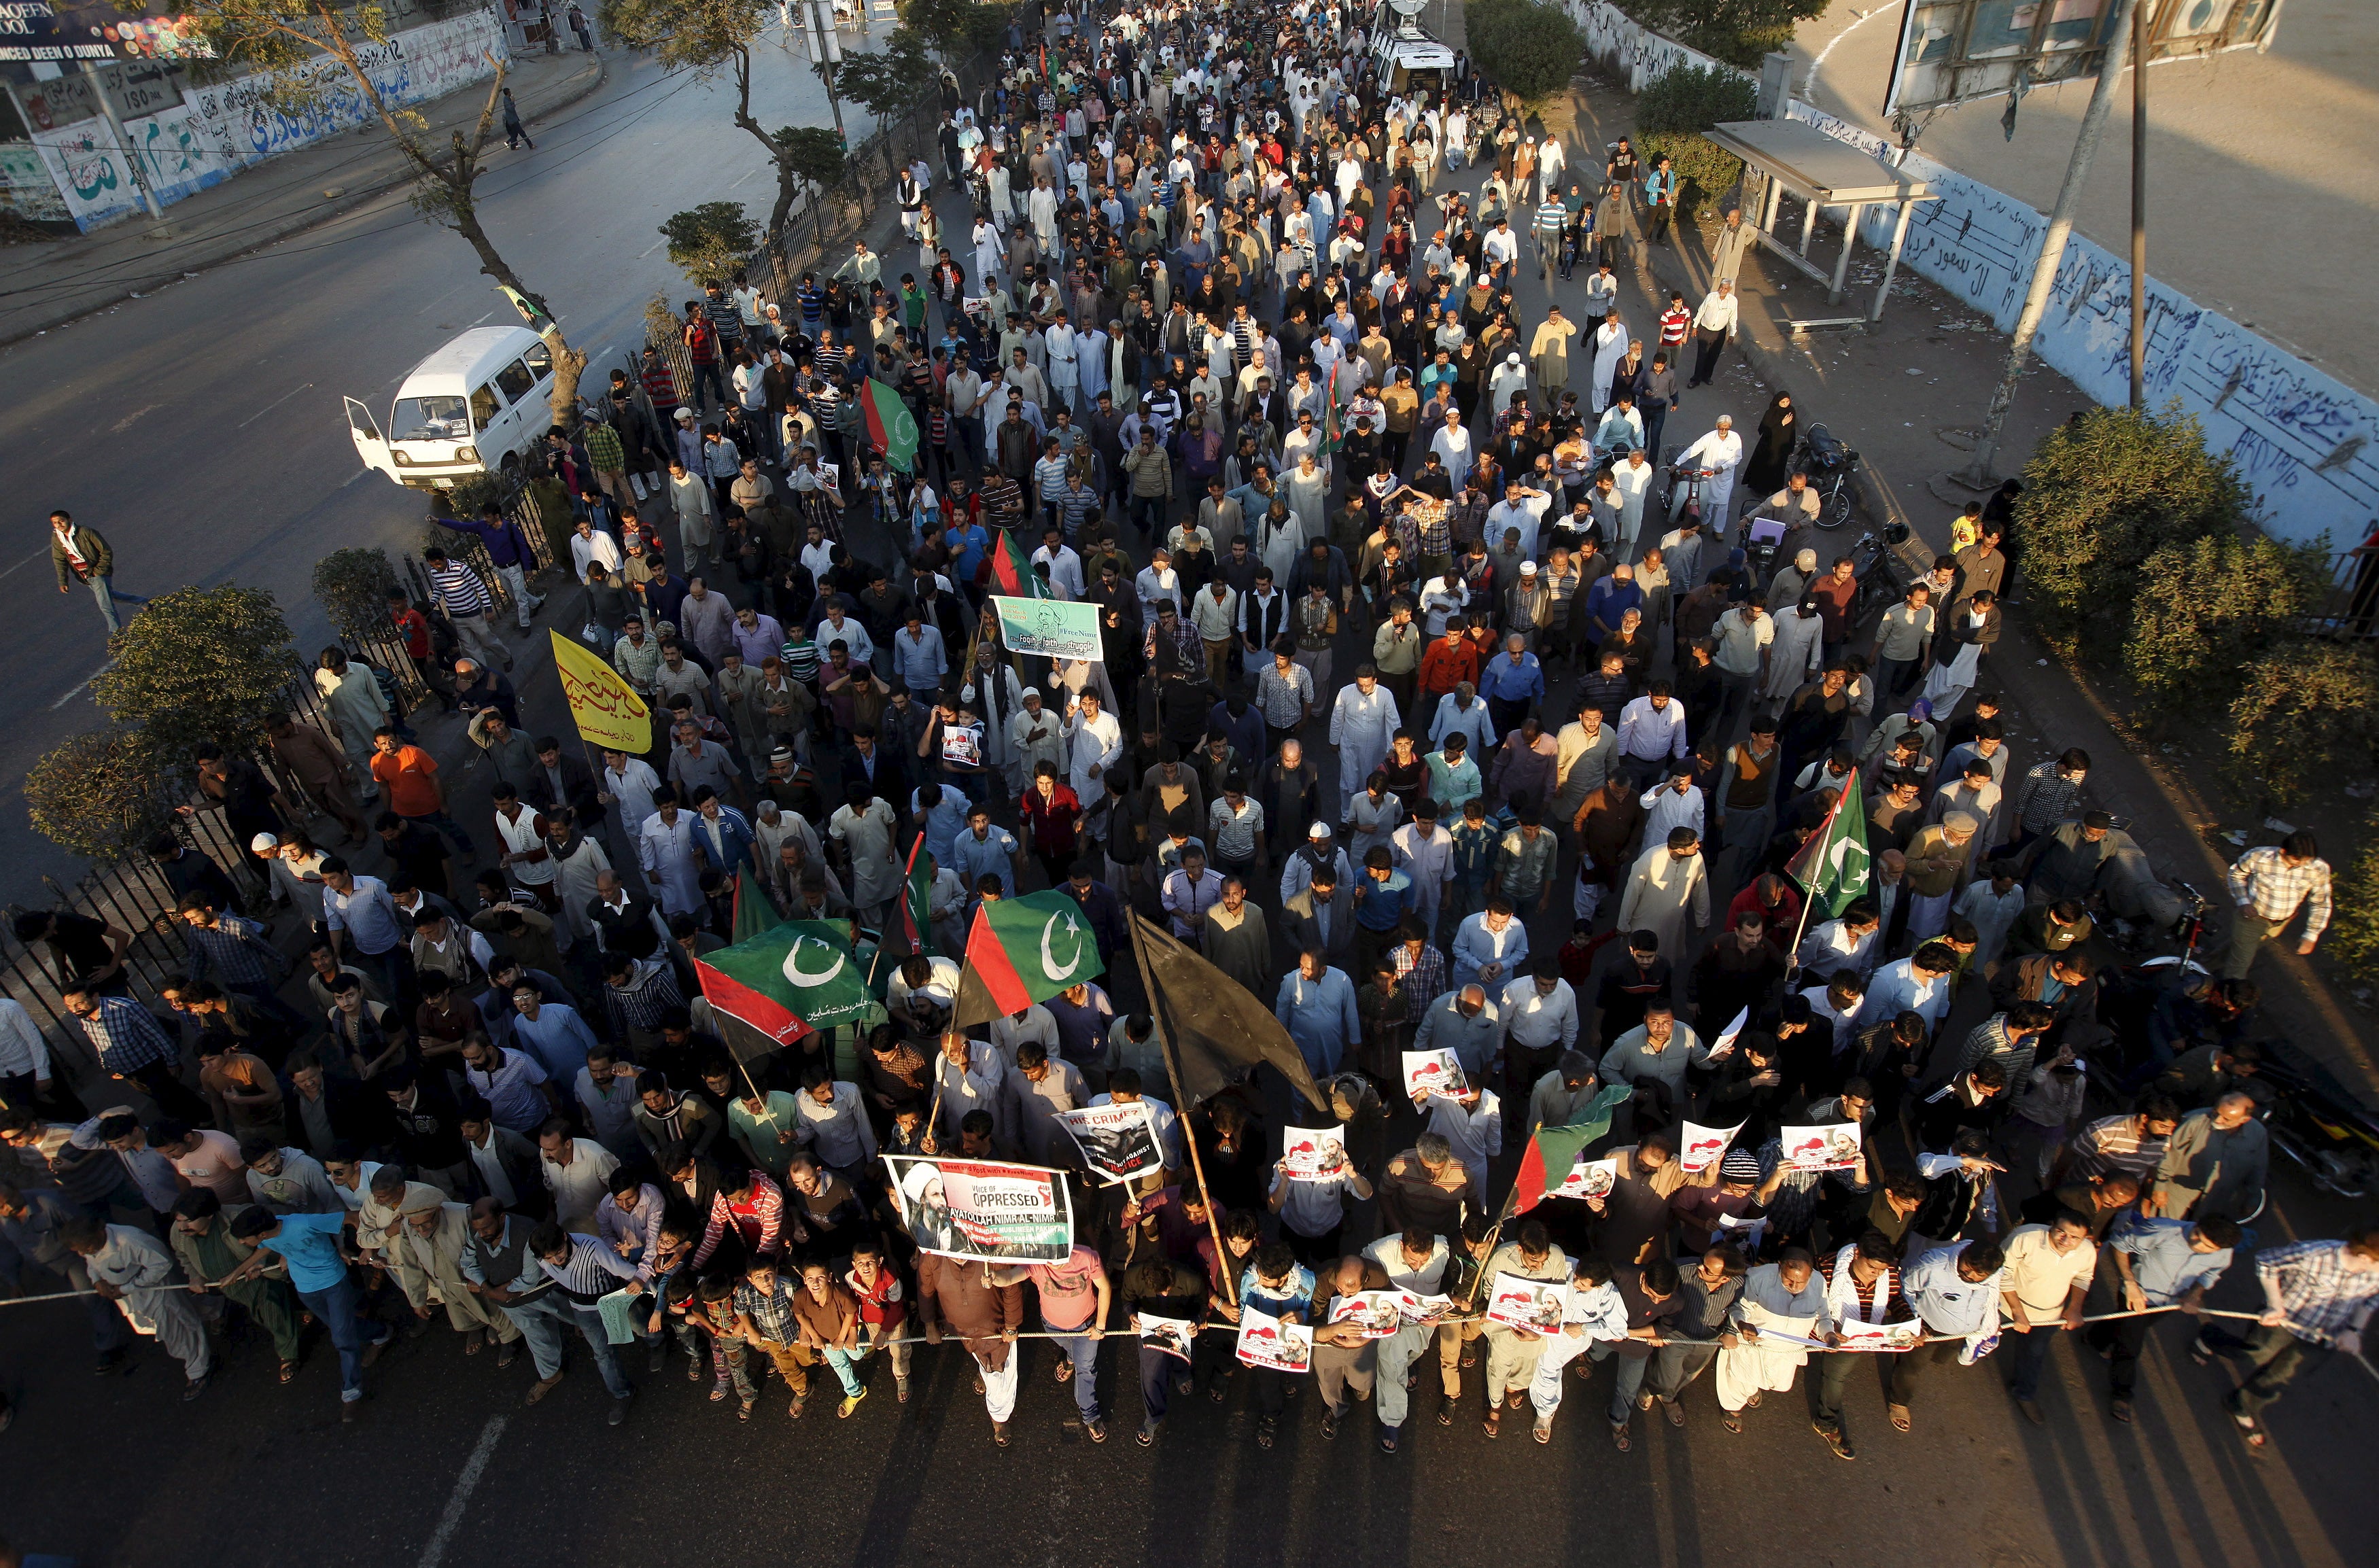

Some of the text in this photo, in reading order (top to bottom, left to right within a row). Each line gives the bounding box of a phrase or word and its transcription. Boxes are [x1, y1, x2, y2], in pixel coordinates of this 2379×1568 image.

[31, 46, 64, 60] DEEN
[63, 46, 74, 58] O
[73, 44, 115, 58] DUNYA
[123, 89, 149, 110] ISO
[1060, 627, 1097, 638] #FreeNimr
[1020, 633, 1037, 645] Faqih
[1042, 637, 1058, 647] faith
[1067, 640, 1094, 653] struggle
[1069, 1110, 1139, 1126] HIS CRIME?
[1126, 1145, 1150, 1161] AGAINST
[941, 1163, 960, 1171] Tweet
[971, 1185, 988, 1194] VOICE
[973, 1193, 1039, 1208] OPPRESSED
[950, 1207, 1056, 1225] AYATOLLAH NIMR AL-NIMR
